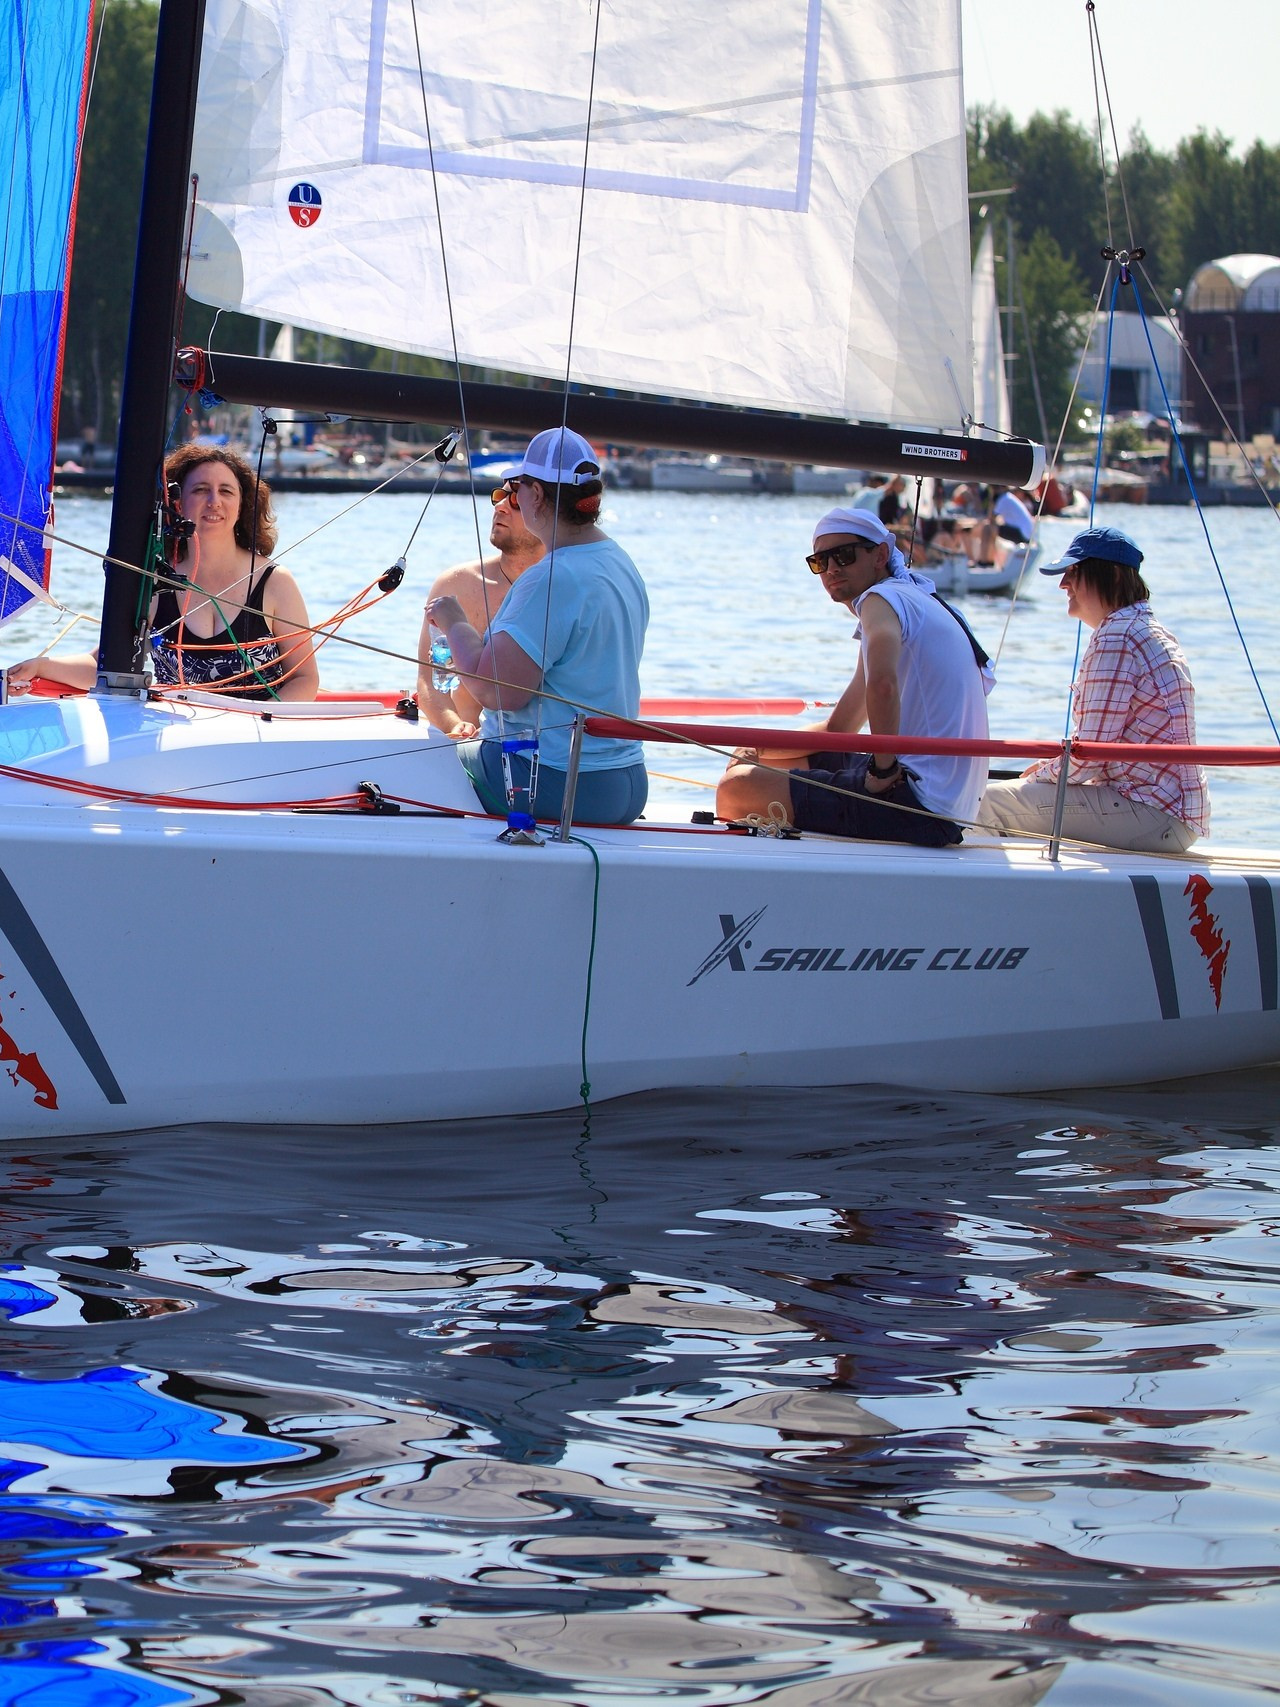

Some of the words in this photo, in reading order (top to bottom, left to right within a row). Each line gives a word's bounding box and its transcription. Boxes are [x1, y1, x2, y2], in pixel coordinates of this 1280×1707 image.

[298, 185, 313, 203] U
[298, 207, 311, 227] S
[904, 445, 923, 454] WIND
[924, 447, 958, 458] BROTHERS
[753, 948, 925, 972] SAILING
[926, 947, 1030, 971] CLUB
